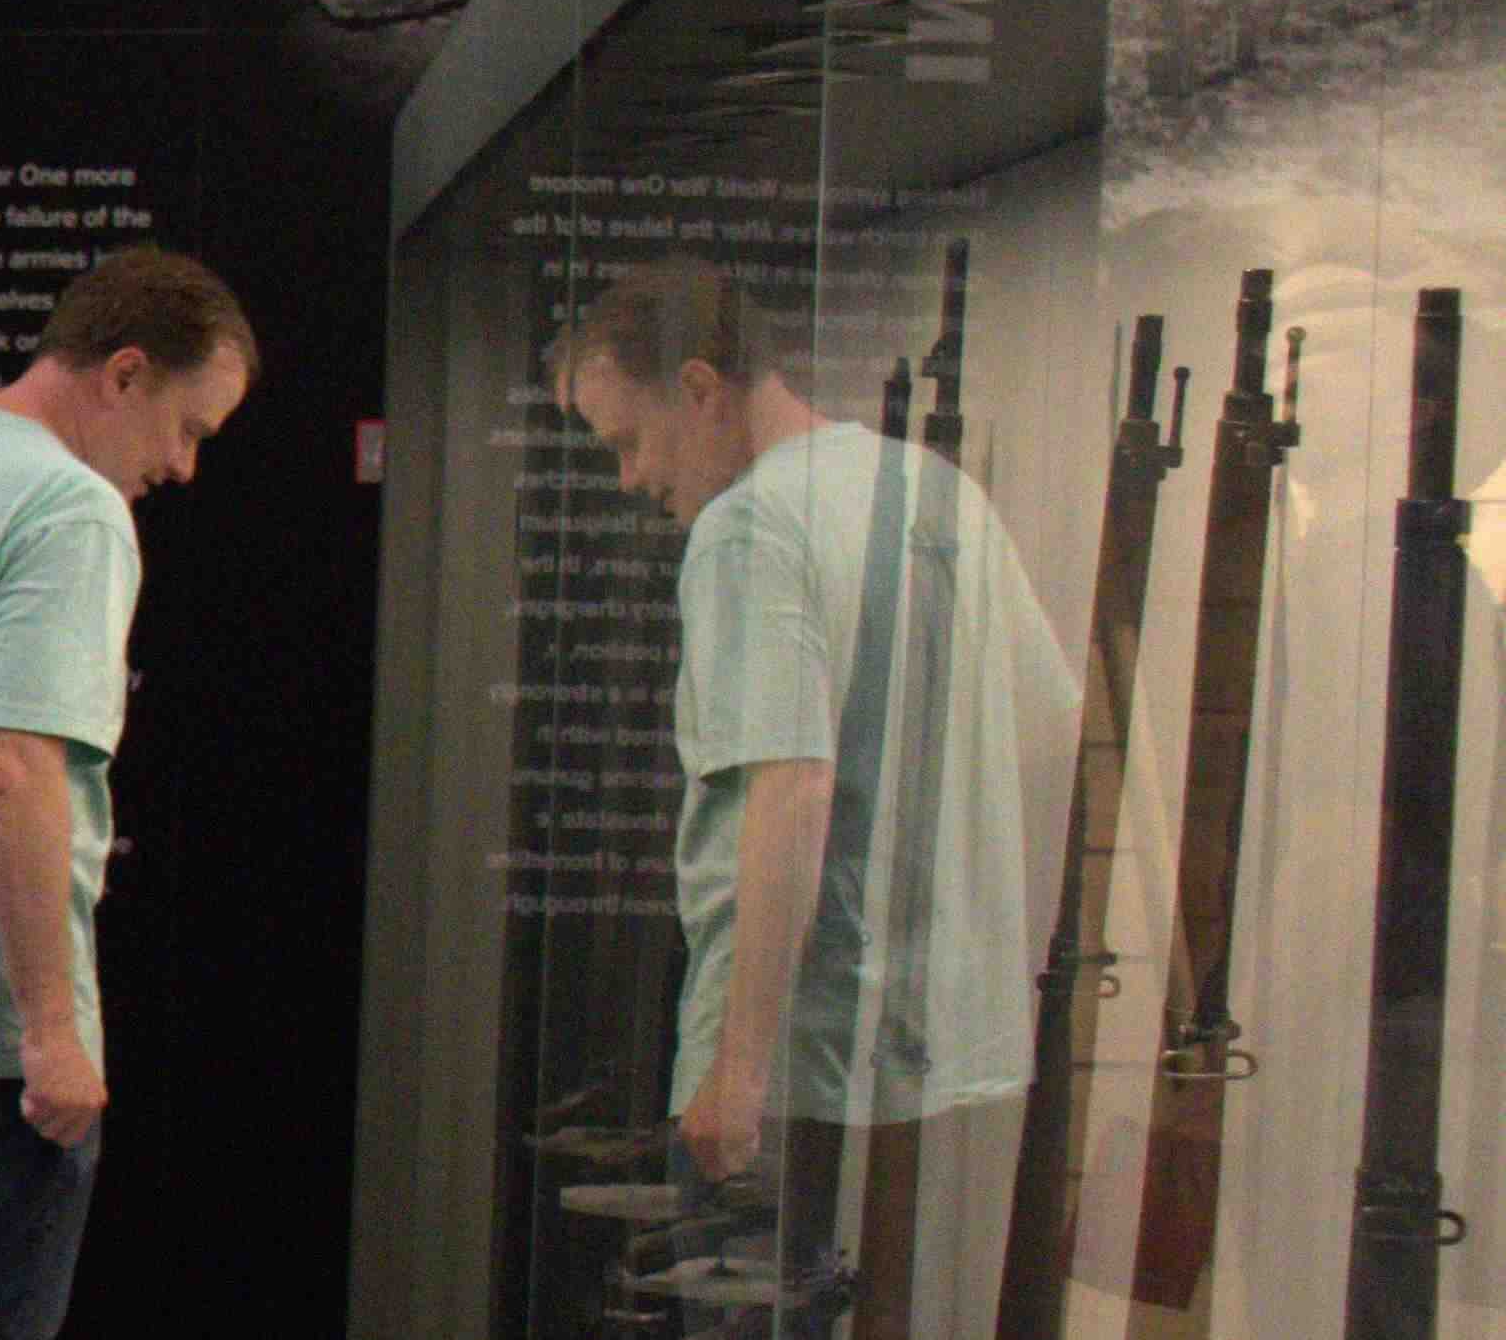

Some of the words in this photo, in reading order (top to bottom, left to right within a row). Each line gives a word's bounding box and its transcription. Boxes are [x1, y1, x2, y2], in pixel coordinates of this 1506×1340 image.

[19, 163, 70, 186] One
[73, 168, 137, 186] more
[4, 206, 79, 227] failure
[83, 206, 110, 227] of
[112, 206, 153, 227] the
[8, 248, 88, 268] armies
